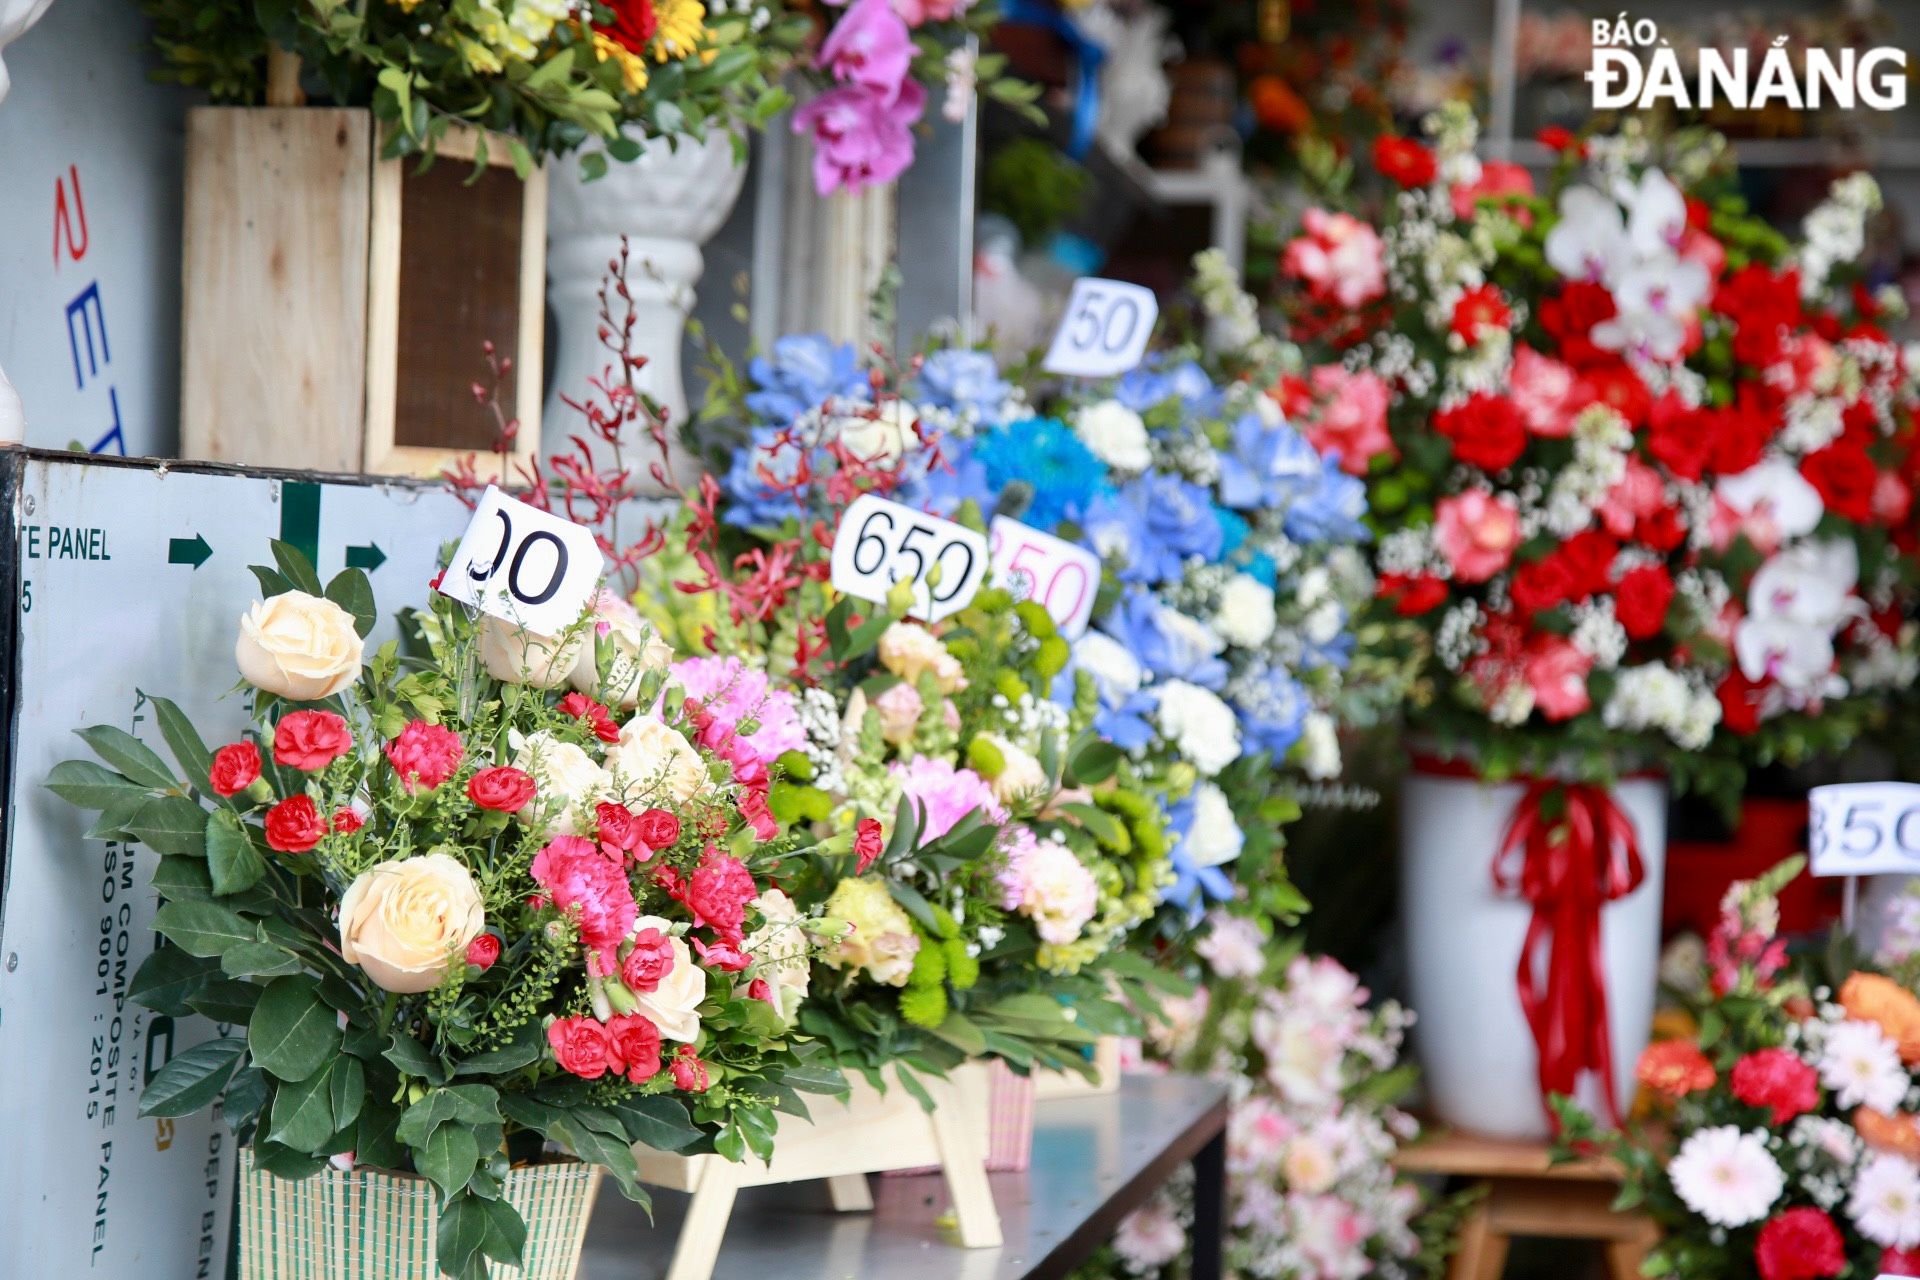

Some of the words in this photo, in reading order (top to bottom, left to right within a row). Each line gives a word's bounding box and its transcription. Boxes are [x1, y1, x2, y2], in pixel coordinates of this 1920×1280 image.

[1071, 291, 1139, 355] 50
[48, 526, 111, 561] PANEL
[854, 511, 974, 602] 650
[22, 580, 32, 613] 5
[102, 840, 118, 904] ISO
[96, 915, 113, 996] 9001
[102, 902, 131, 1130] COMPOSITE
[86, 1036, 104, 1120] 2015
[91, 1141, 112, 1268] PANEL
